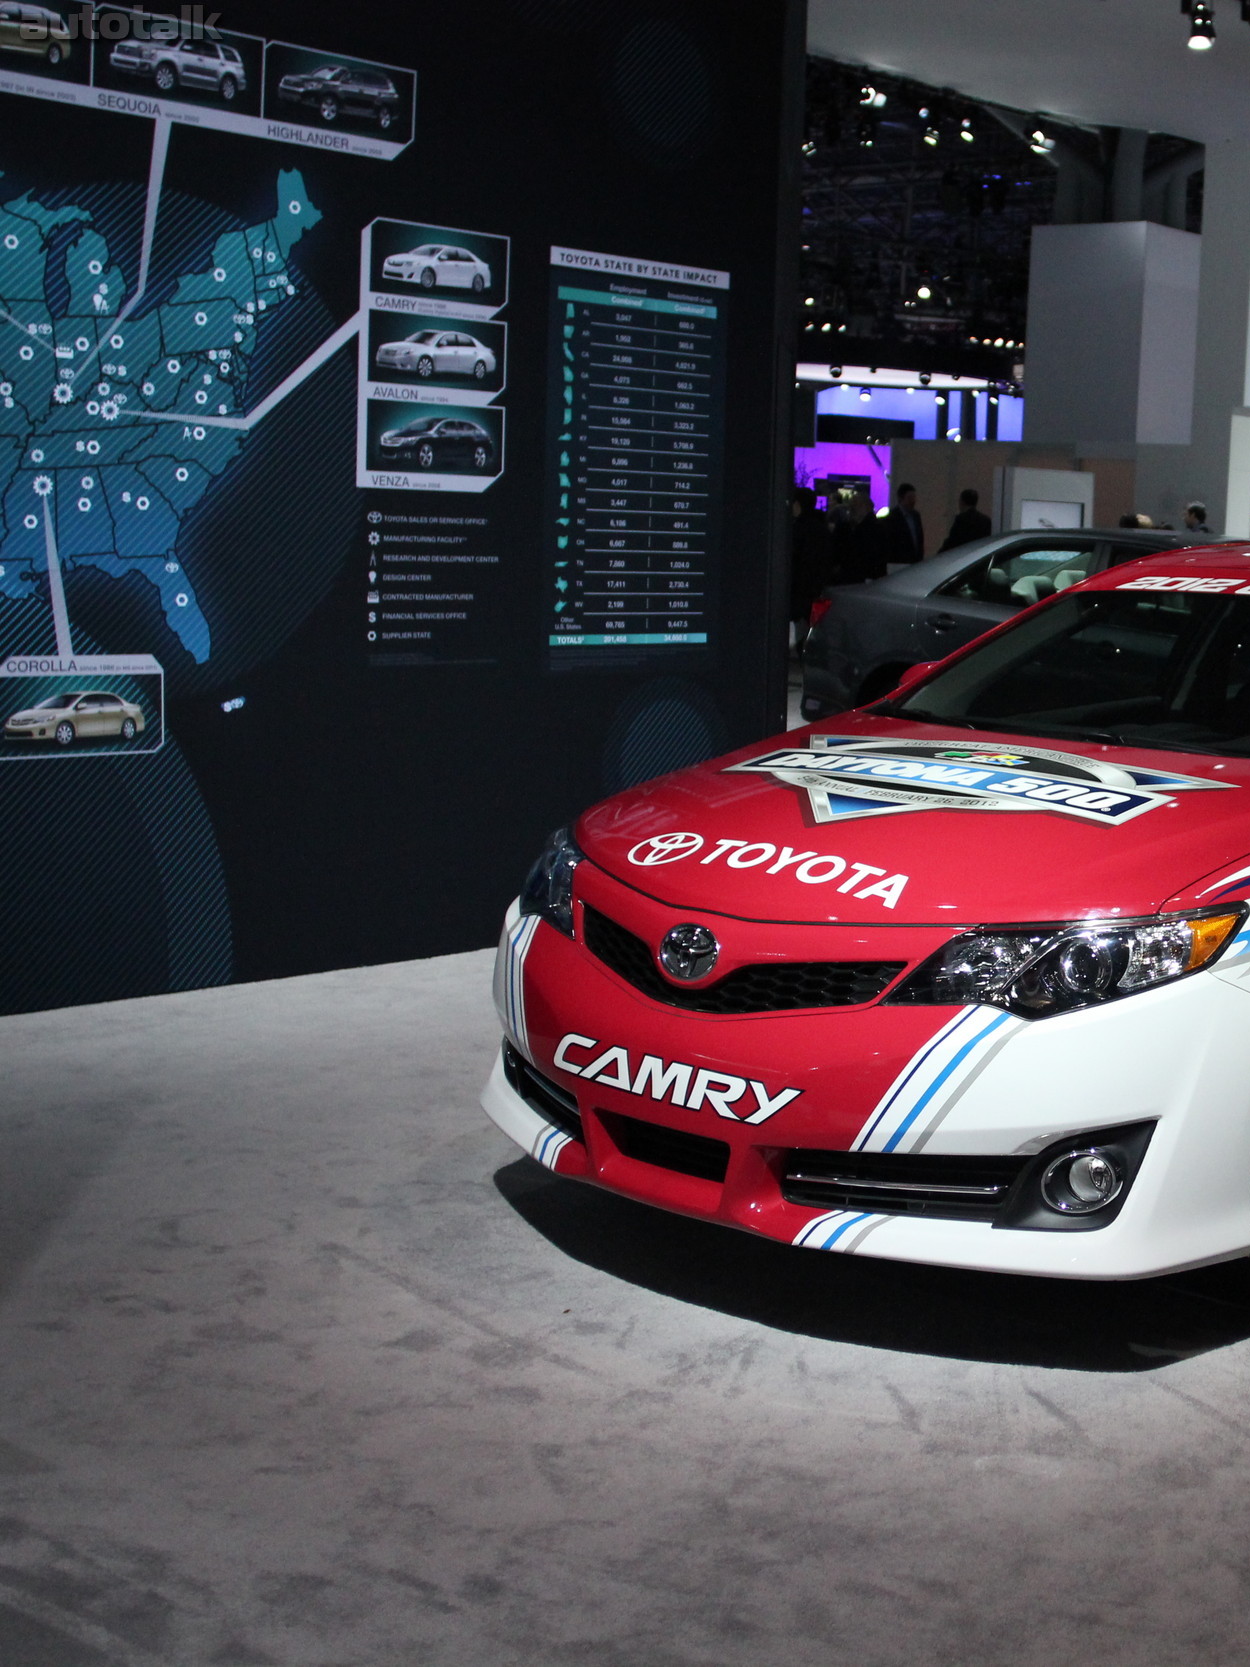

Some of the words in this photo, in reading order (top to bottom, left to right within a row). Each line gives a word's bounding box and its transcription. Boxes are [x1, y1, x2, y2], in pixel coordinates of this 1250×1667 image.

[97, 92, 161, 117] SEQUOIA
[266, 124, 349, 150] HIGHLANDER
[560, 252, 600, 267] TOYOTA
[604, 259, 633, 273] STATE
[636, 264, 649, 274] BY
[652, 265, 680, 279] STATE
[683, 270, 718, 284] IMPACT
[374, 296, 417, 311] CAMRY
[373, 386, 418, 400] AVALON
[372, 475, 410, 488] VENZA
[384, 515, 407, 523] TOYOTA
[439, 517, 463, 525] SERVICE
[383, 535, 436, 543] MANUFACTURING
[383, 554, 416, 562] RESEARCH
[431, 555, 474, 563] DEVELOPMENT
[1115, 576, 1247, 592] 2012
[382, 593, 424, 601] CONTRACTED
[425, 593, 474, 601] MANUFACTURER
[382, 612, 414, 620] FINANCIAL
[415, 612, 444, 620] SERVICES
[382, 632, 412, 640] SUPPLIER
[413, 631, 431, 639] STATE
[6, 660, 78, 673] COROLLA
[761, 753, 996, 788] DAYTONA
[986, 777, 1131, 811] 500
[863, 789, 934, 803] FEBRUARY
[959, 799, 1000, 807] 2012
[700, 838, 909, 909] TOYOTA
[553, 1033, 805, 1126] CAMRY
